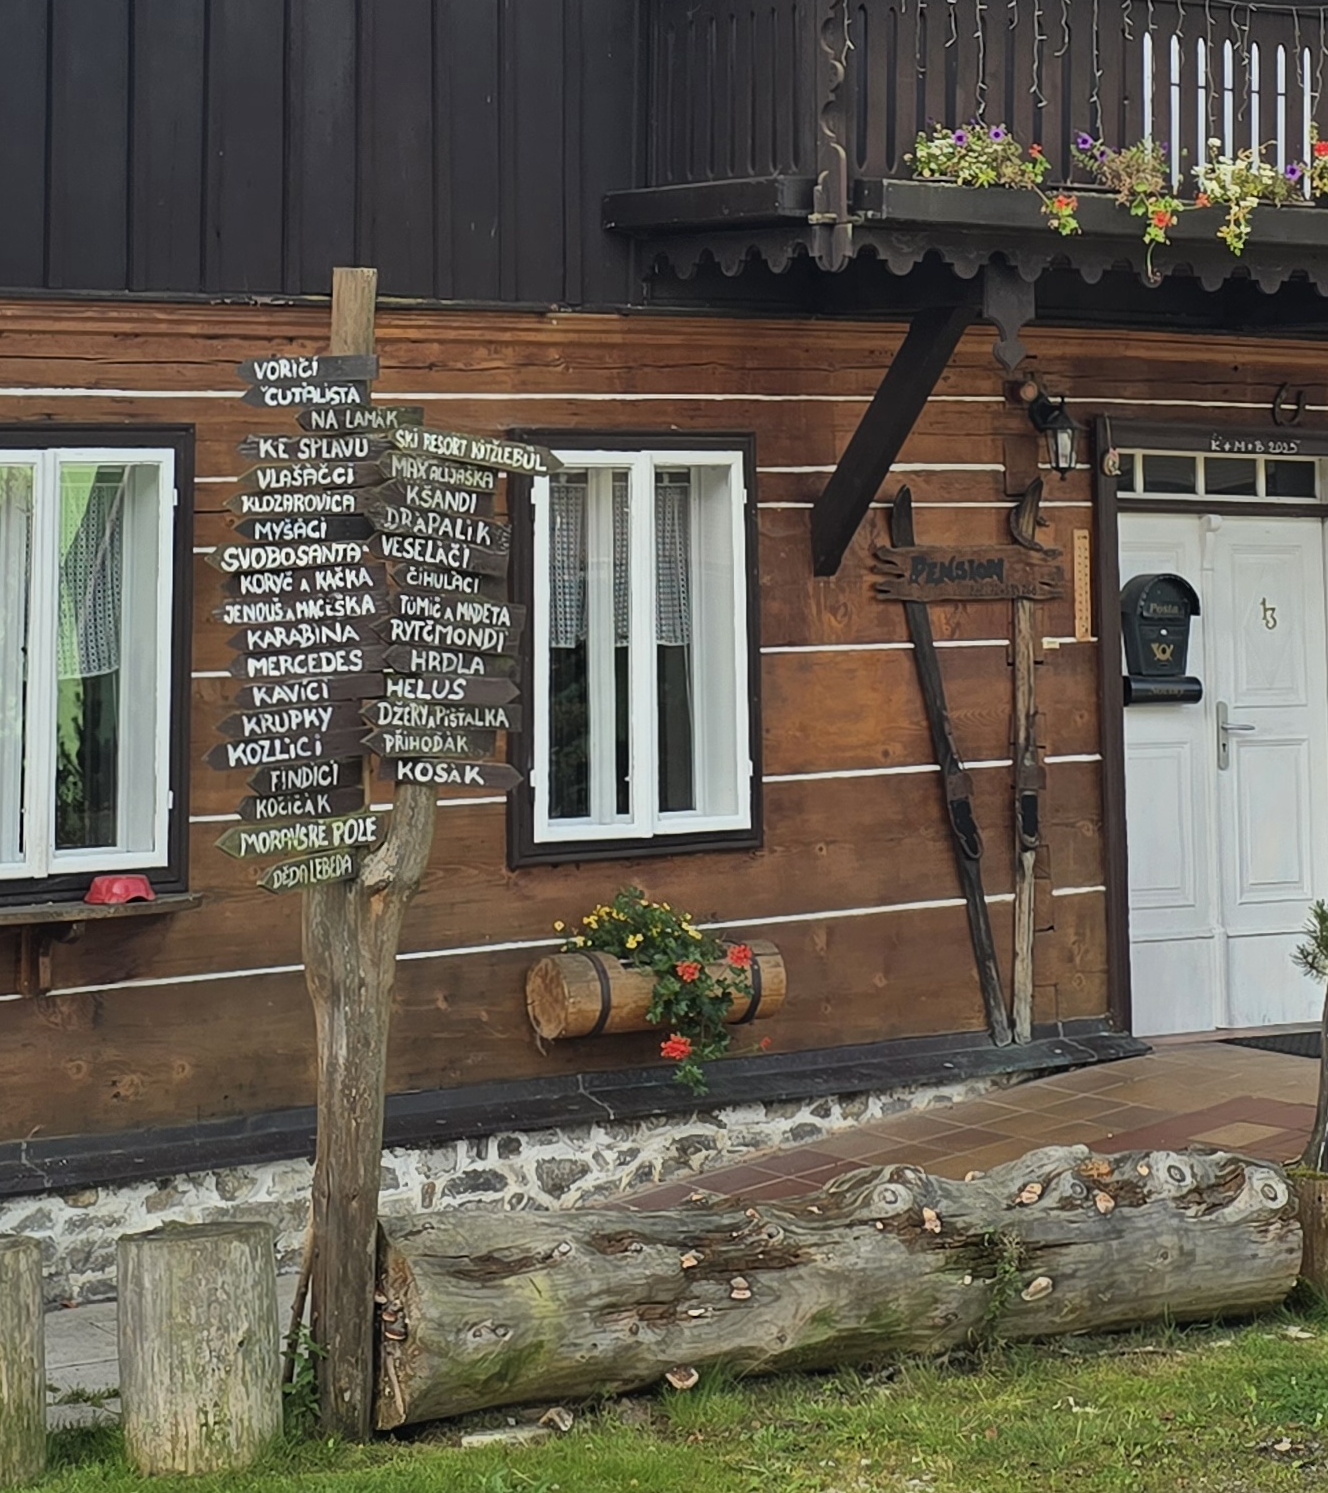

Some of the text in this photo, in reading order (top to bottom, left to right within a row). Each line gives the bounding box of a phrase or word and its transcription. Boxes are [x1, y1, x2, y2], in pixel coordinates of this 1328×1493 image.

[310, 410, 338, 429] NA
[258, 437, 370, 459] KE SPLAVU
[394, 427, 419, 449] SKI
[423, 432, 468, 457] RESORT
[299, 578, 311, 593] A
[315, 566, 374, 591] KAČKA
[909, 554, 1006, 586] PENSION
[443, 606, 455, 623] A
[246, 649, 363, 678] MERCEDES
[410, 649, 486, 675] HRDLA
[386, 678, 468, 701] HELUS
[241, 706, 333, 737] KRUPKY
[397, 759, 486, 786] KOSÁK
[331, 816, 378, 847] POLE
[309, 853, 353, 883] LEBEDA
